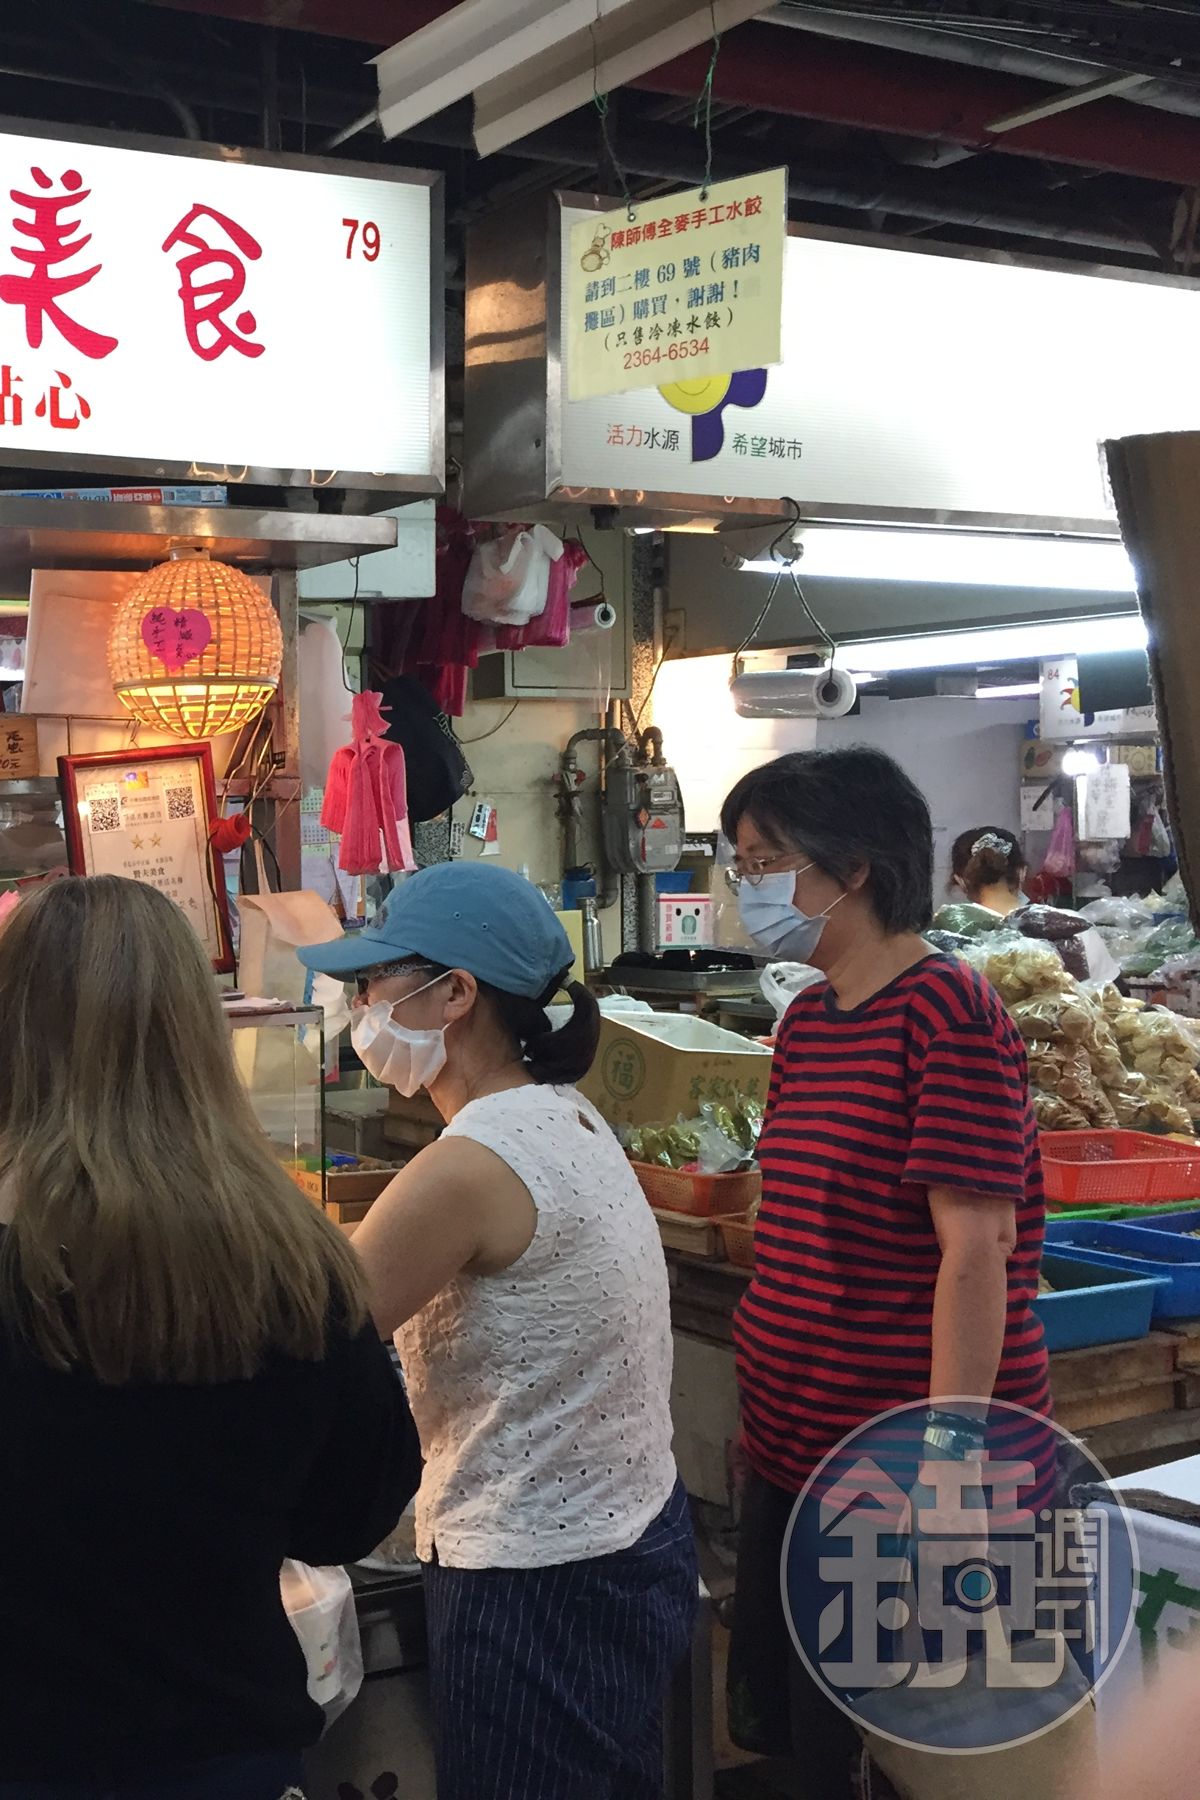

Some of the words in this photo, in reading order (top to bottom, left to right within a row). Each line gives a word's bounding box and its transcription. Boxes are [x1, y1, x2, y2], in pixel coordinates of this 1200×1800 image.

[610, 196, 762, 250] 陳師傅全麥手工水餃
[341, 219, 381, 261] 79
[623, 337, 709, 370] 2364-6534
[607, 423, 680, 452] 活力水源
[732, 432, 803, 460] 希望城市
[1047, 669, 1059, 680] 84
